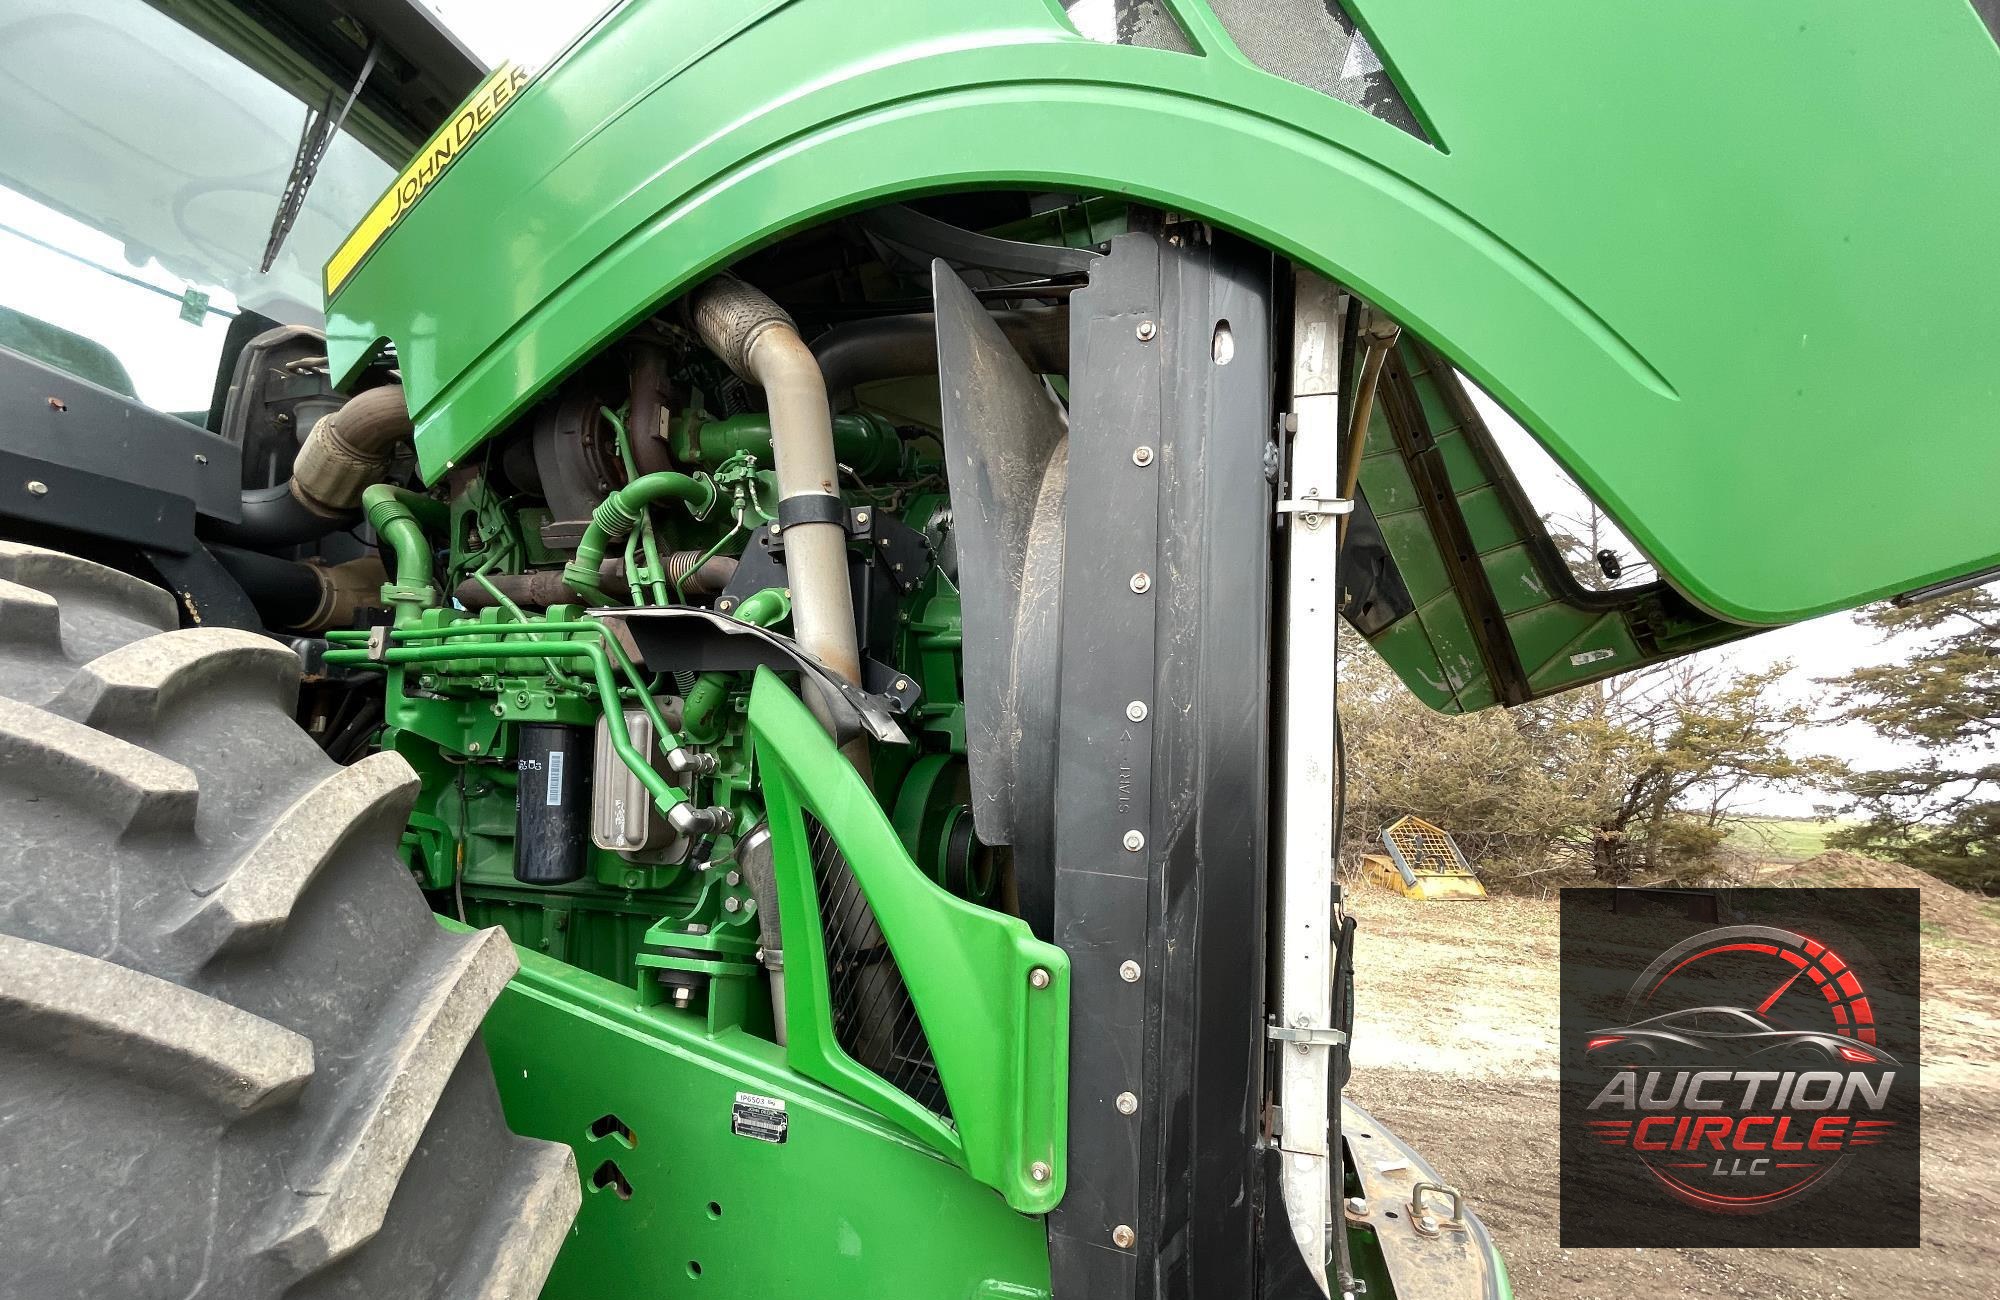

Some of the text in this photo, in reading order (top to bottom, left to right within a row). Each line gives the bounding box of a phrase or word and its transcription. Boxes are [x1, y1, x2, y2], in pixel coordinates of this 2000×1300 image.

[390, 64, 536, 222] JOHN DEER
[1118, 763, 1131, 815] START
